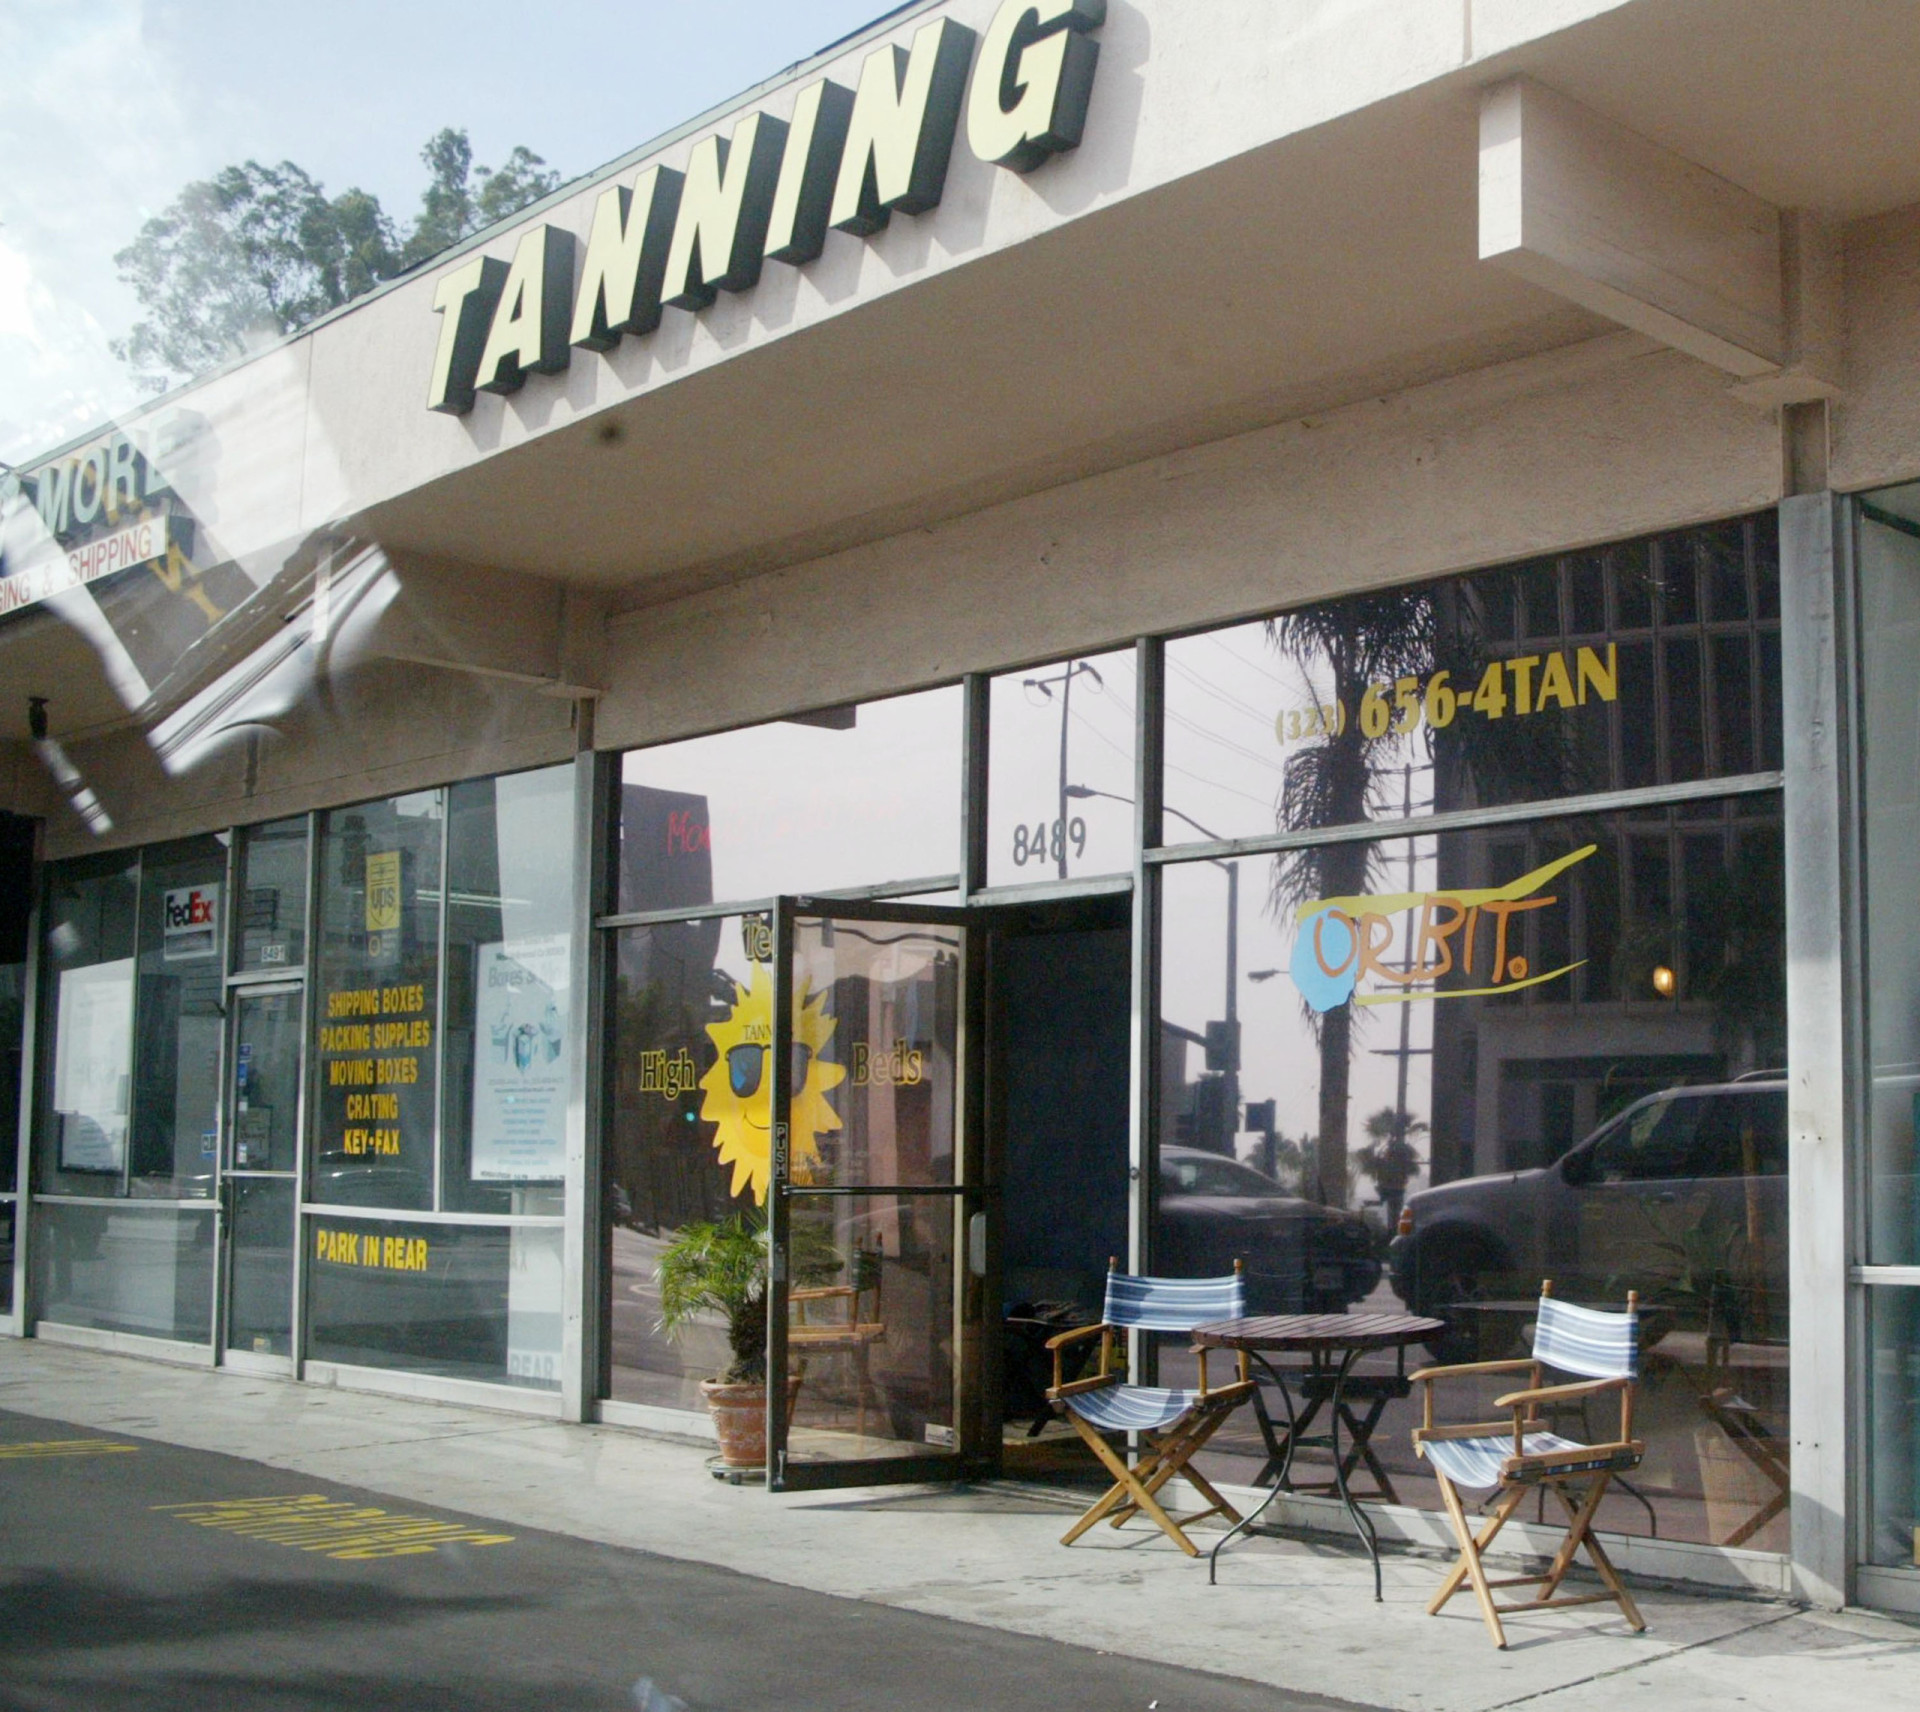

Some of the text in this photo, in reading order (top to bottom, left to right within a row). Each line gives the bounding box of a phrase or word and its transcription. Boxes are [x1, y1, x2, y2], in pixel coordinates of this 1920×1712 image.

[428, 0, 1106, 415] TANNING
[68, 524, 151, 585] SHIPPING
[1275, 642, 1617, 746] (323) 656-4TAN
[1013, 816, 1086, 866] 8489
[165, 890, 213, 928] FedEx
[328, 984, 424, 1017] SHIPPING BOXES
[320, 1020, 429, 1052] PACKING SUPPLIES
[330, 1057, 418, 1086] MOVING BOXES
[640, 1048, 696, 1100] High
[852, 1038, 922, 1086] Beds
[347, 1092, 398, 1120] CRATING
[776, 1126, 786, 1178] PUSH
[317, 1230, 427, 1272] PARK IN REAR
